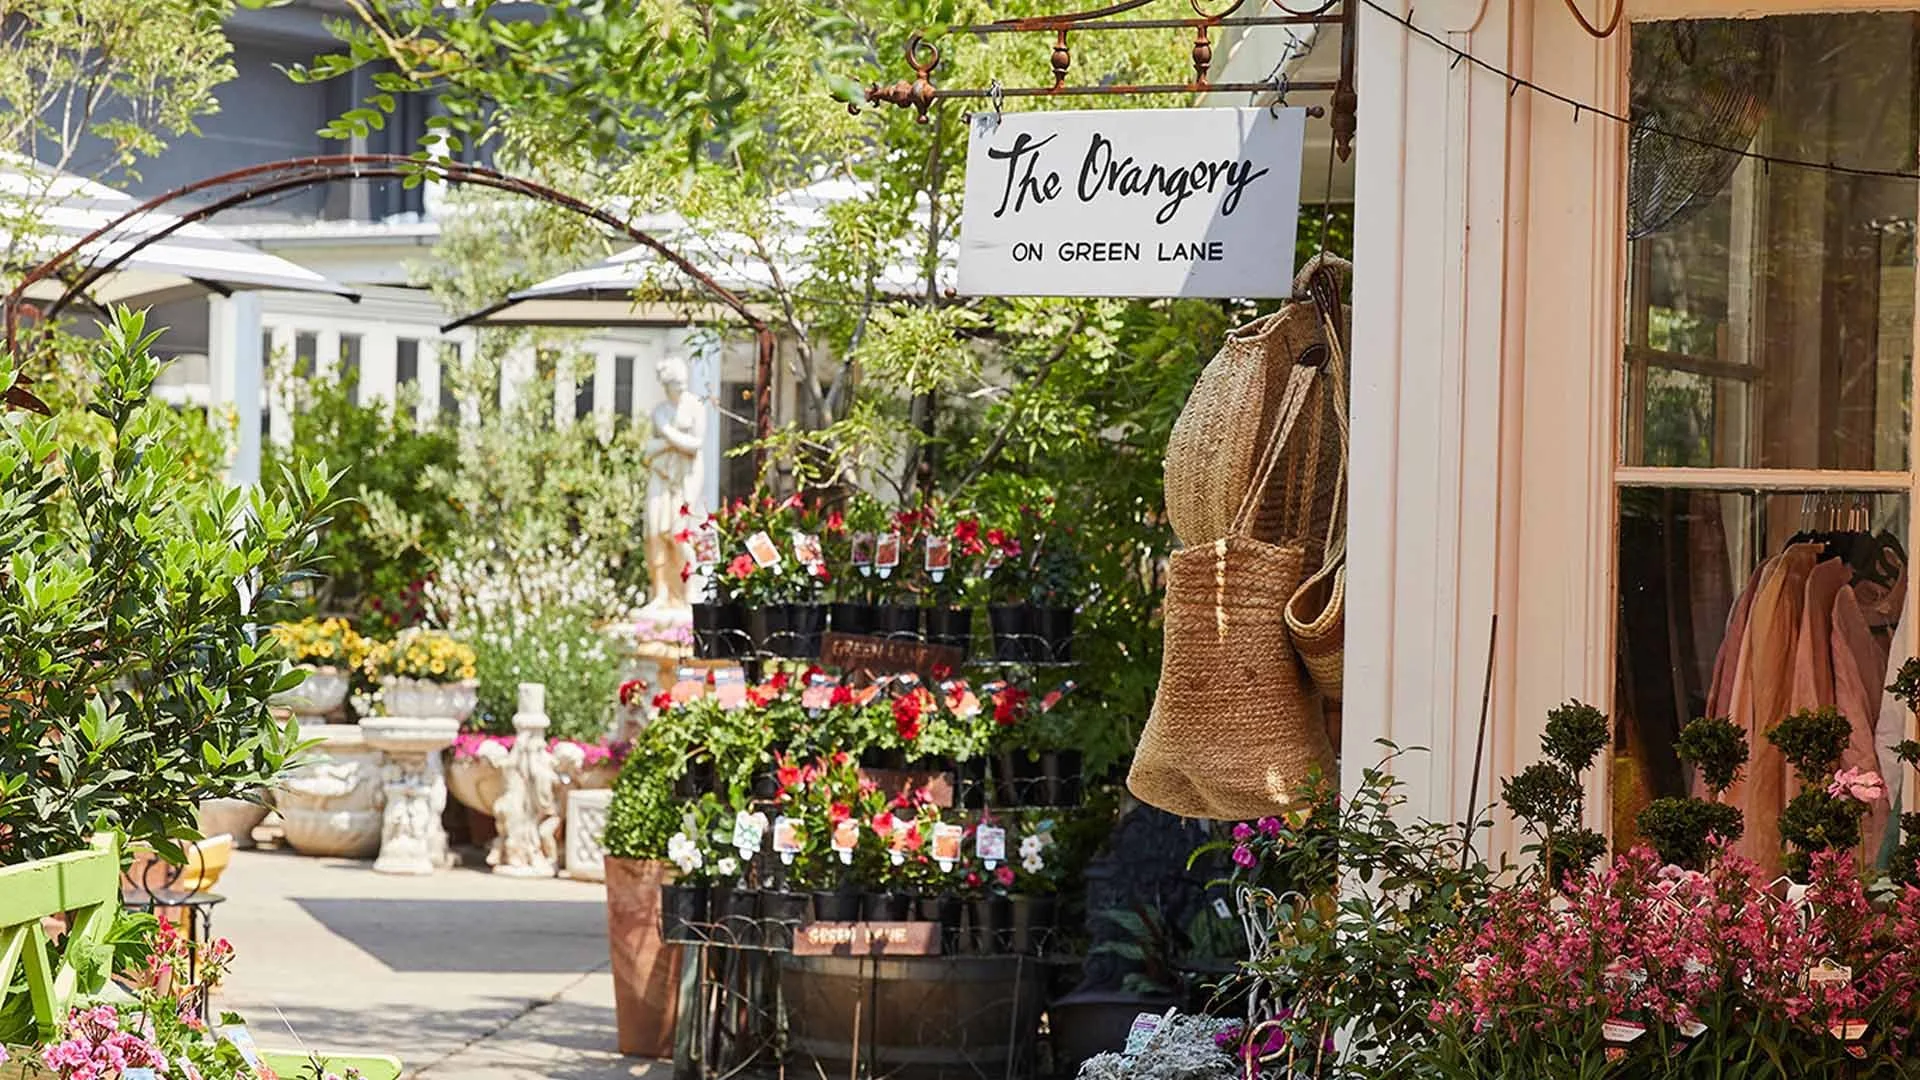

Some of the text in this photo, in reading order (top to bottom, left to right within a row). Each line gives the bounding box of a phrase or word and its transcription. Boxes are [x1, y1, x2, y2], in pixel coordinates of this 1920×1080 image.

[988, 132, 1270, 224] The Orangery
[1012, 242, 1224, 262] ON GREEN LANE
